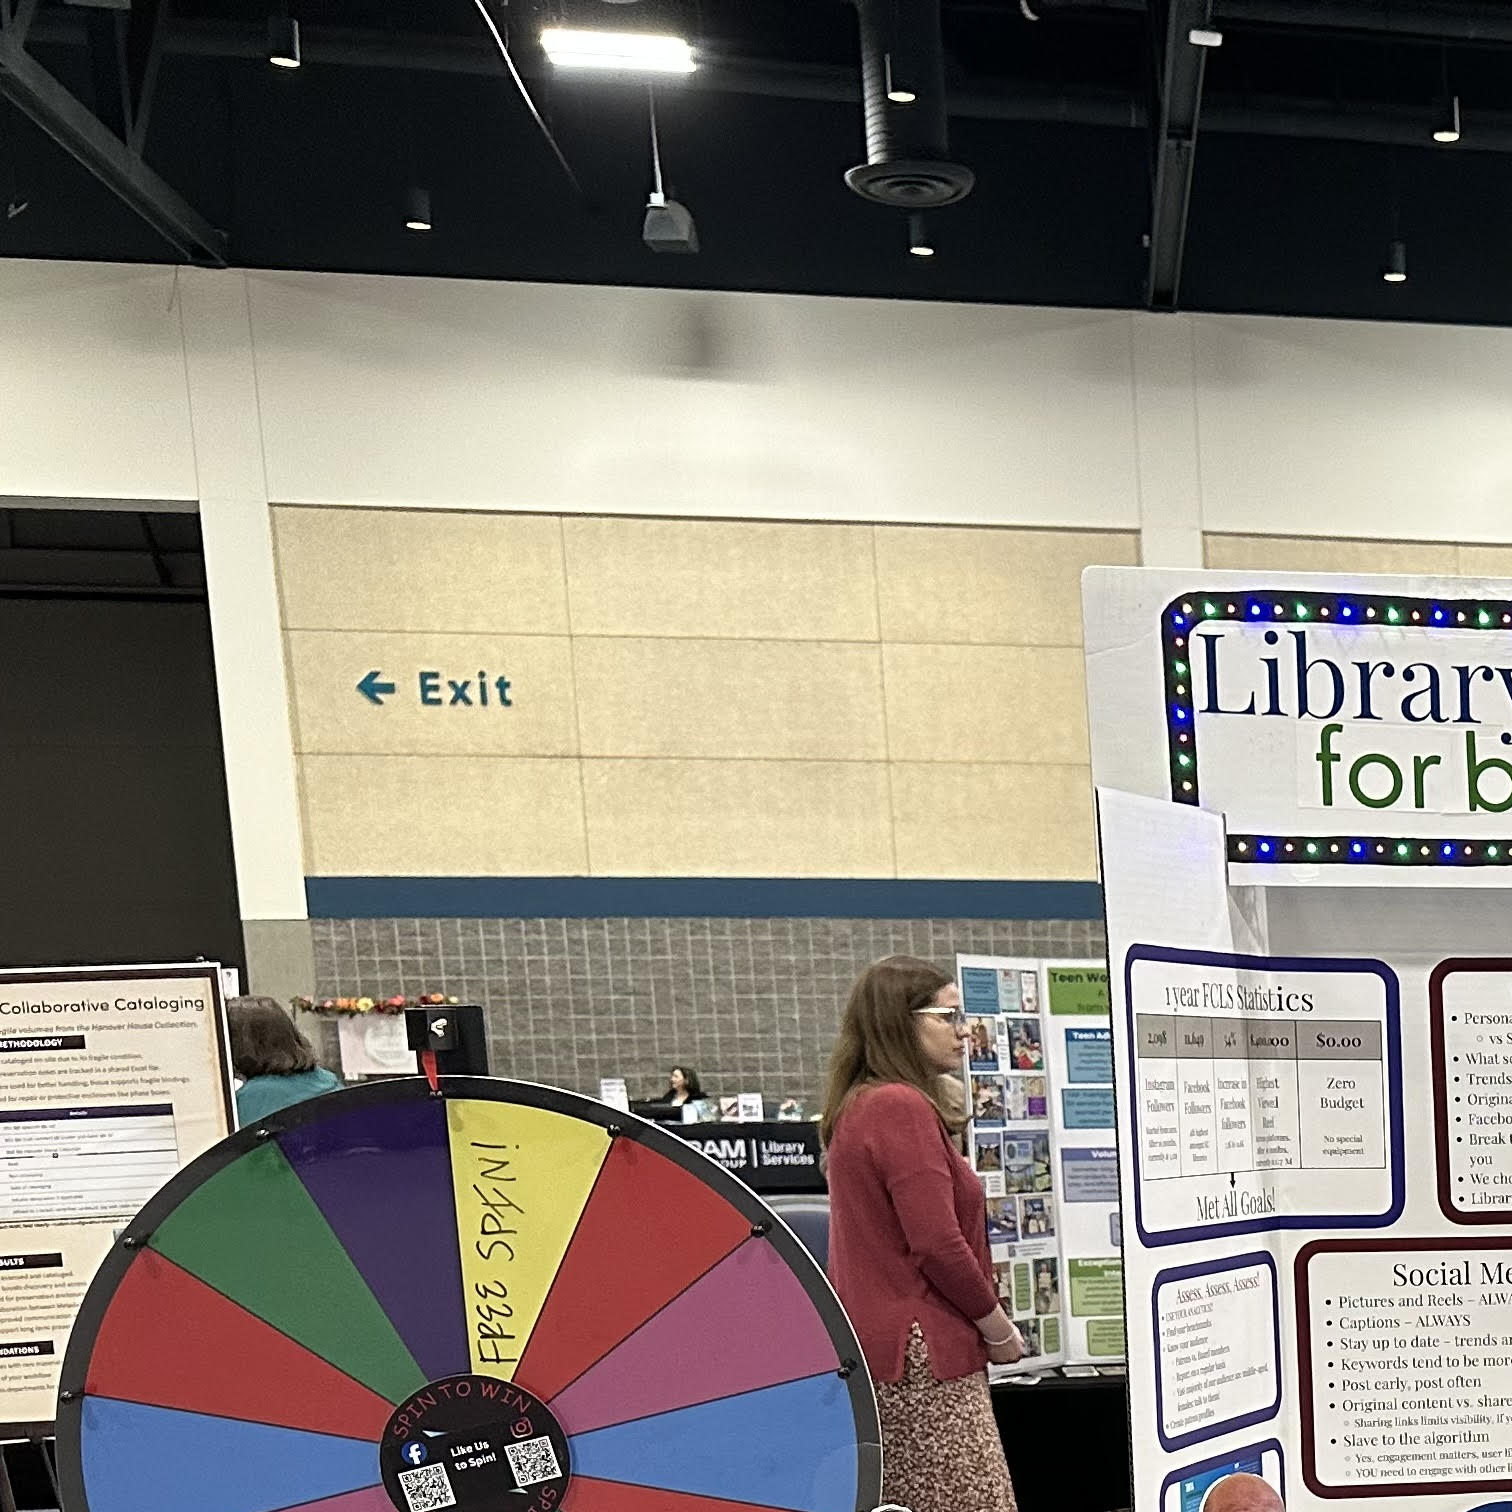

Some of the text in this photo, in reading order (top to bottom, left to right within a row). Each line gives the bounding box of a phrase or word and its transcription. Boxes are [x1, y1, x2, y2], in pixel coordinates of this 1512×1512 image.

[419, 670, 513, 708] Exit
[1317, 725, 1439, 809] for
[1051, 972, 1108, 983] Teen Wo
[0, 997, 204, 1015] Collaborative Cataloging
[1166, 983, 1314, 1012] 1 year FCLS Statistics
[1316, 1032, 1362, 1049] $0.00
[1489, 1035, 1503, 1045] vs
[1465, 1052, 1500, 1065] What
[1326, 1077, 1356, 1090] Zero
[1320, 1096, 1365, 1112] Budget
[761, 1140, 806, 1156] Library
[1324, 1135, 1363, 1145] No special
[762, 1154, 815, 1166] Services
[1196, 1186, 1276, 1221] Met All Goals!
[470, 1142, 525, 1364] FREE SPIN!
[1393, 1260, 1472, 1287] Social
[1342, 1376, 1481, 1393] Post early, post often
[394, 1382, 531, 1438] SPIN TO WIN
[450, 1441, 490, 1458] Like Us
[454, 1452, 497, 1471] to Spin!
